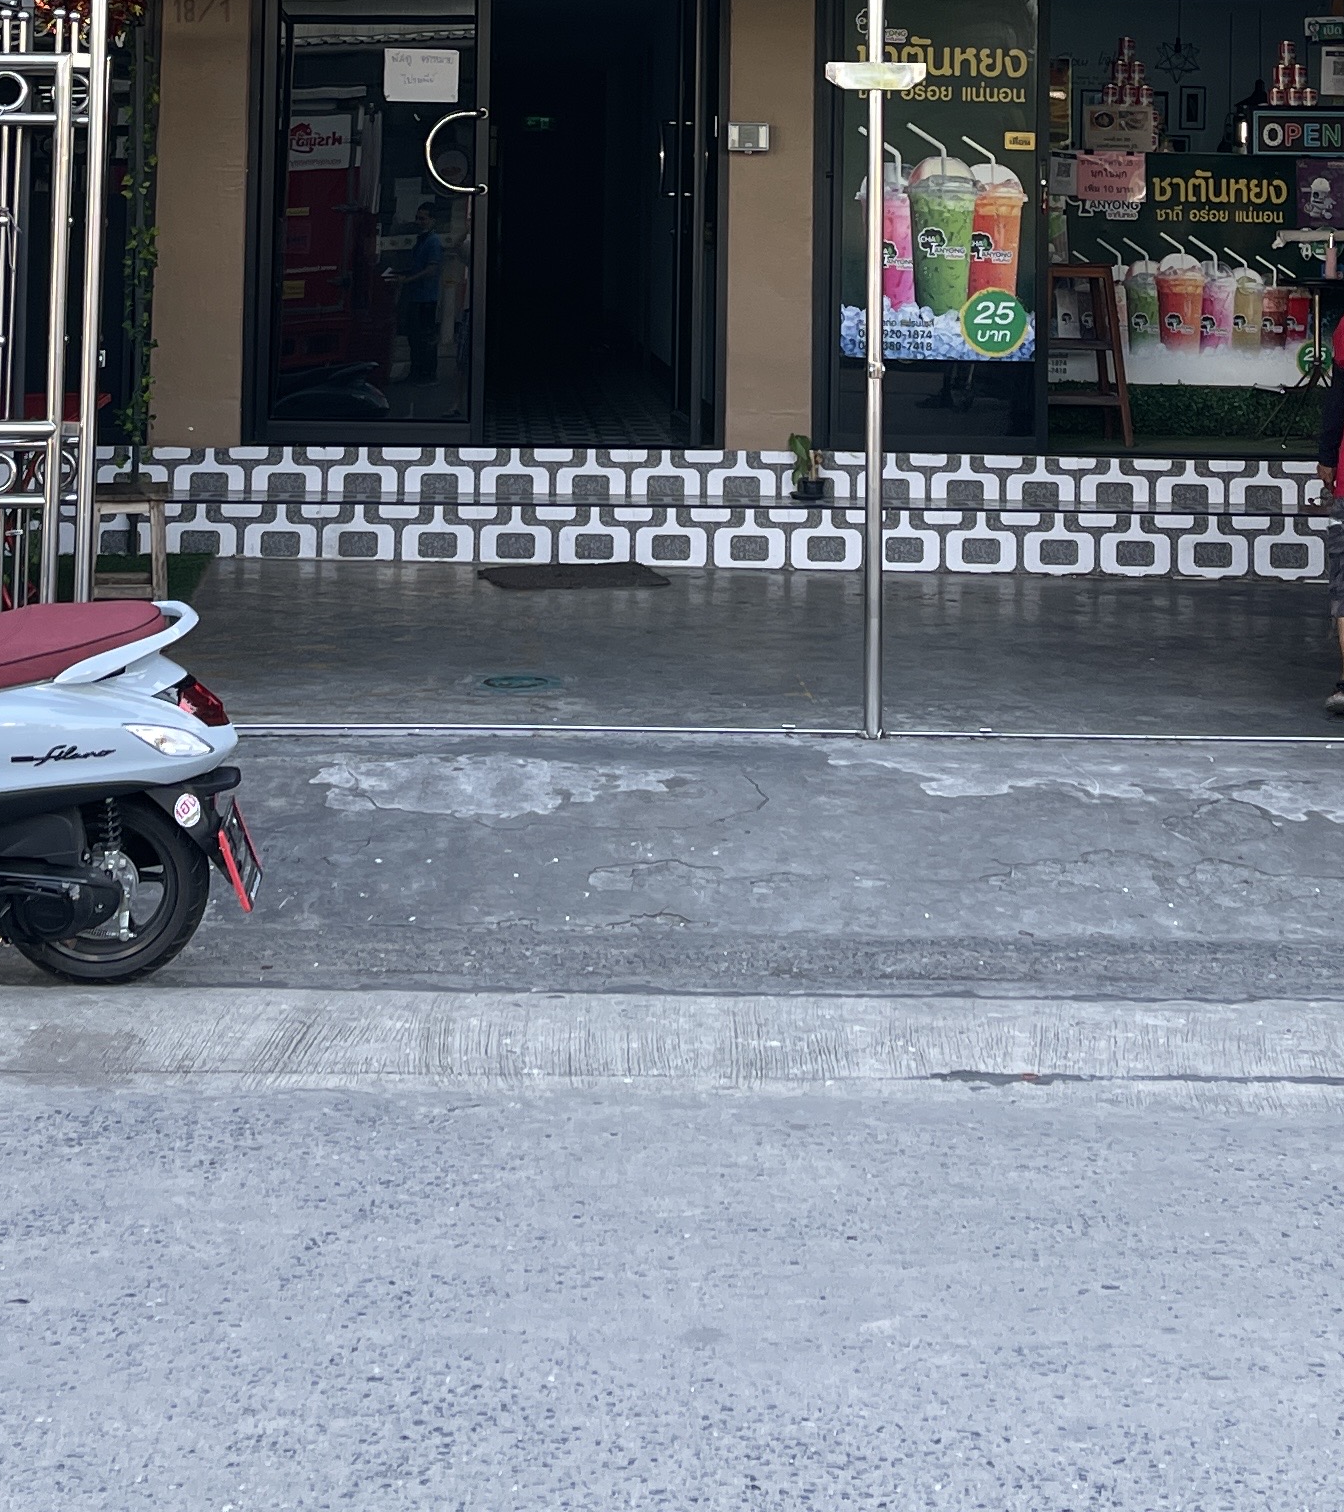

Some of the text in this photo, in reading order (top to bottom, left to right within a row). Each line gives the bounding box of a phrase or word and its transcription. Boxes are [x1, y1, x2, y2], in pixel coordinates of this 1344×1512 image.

[962, 81, 1026, 103] แน่นอน
[1262, 122, 1341, 149] OPEN
[1152, 169, 1289, 207] ชาตันหยง
[1189, 205, 1230, 224] อร่อย
[1235, 206, 1285, 225] แน่นอน
[973, 301, 1015, 325] 25
[977, 326, 1012, 342] บาท
